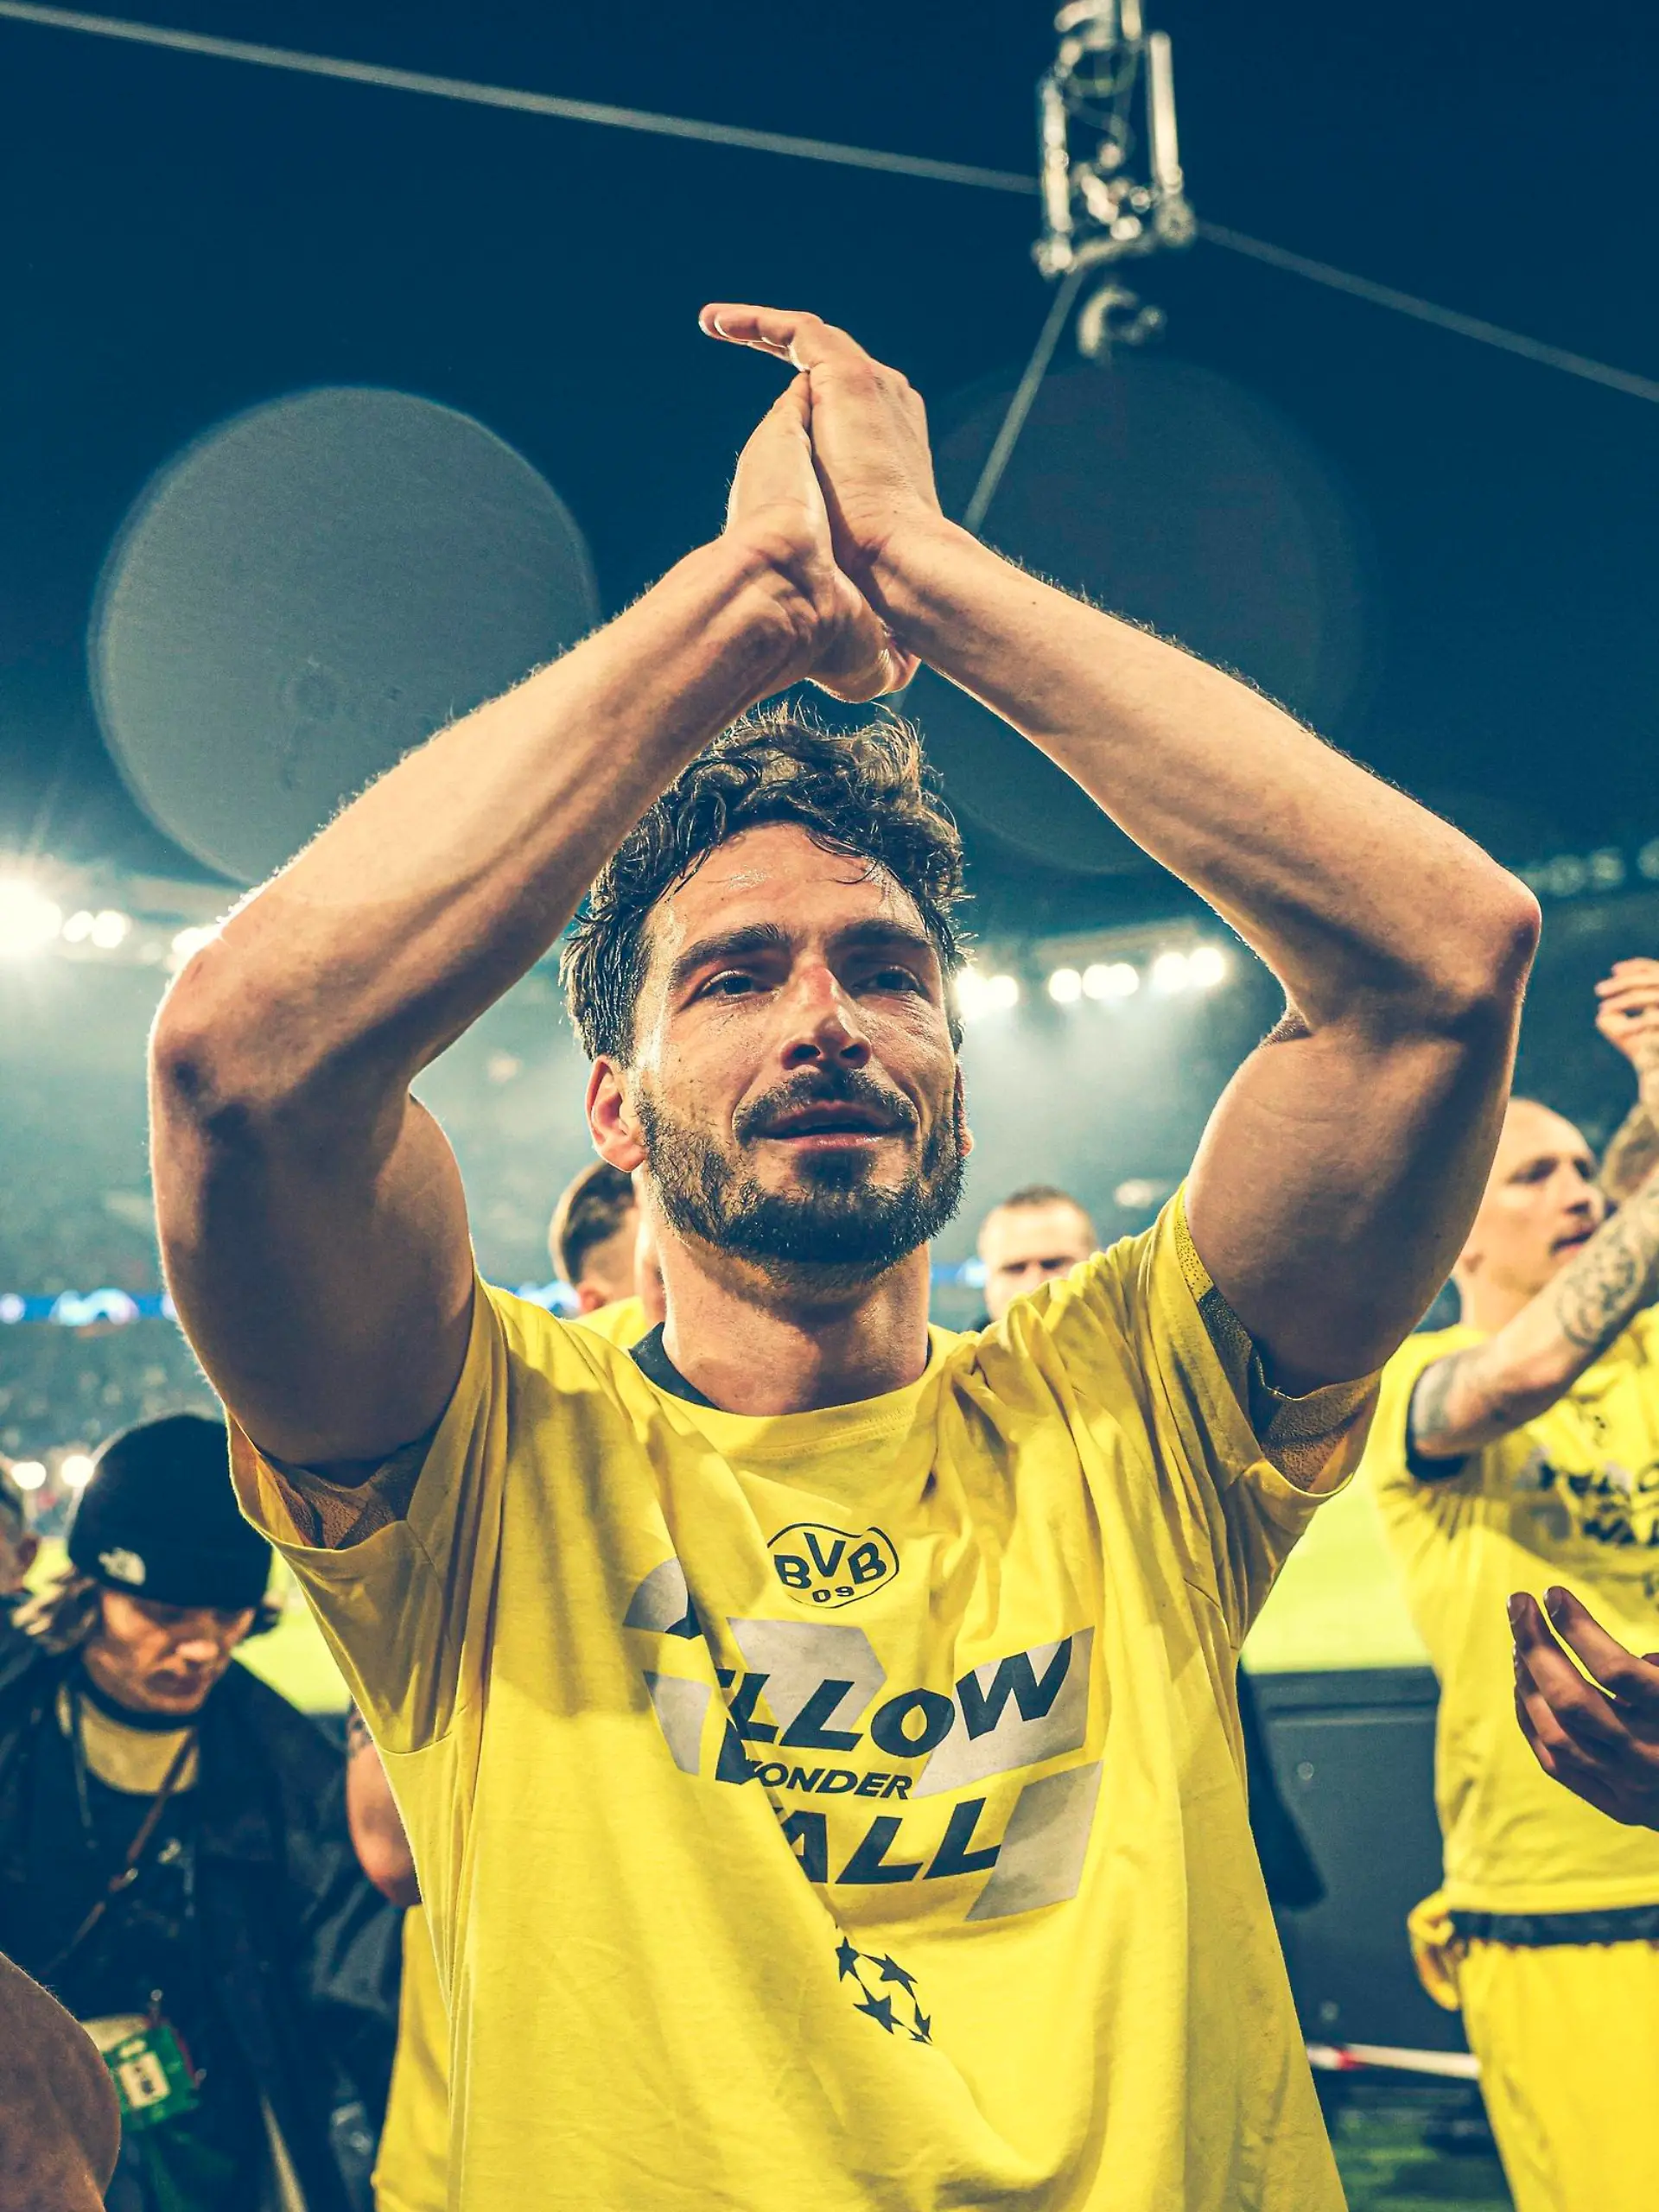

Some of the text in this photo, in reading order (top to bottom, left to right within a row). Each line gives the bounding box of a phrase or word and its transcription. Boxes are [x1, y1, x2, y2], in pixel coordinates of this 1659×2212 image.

[773, 1532, 887, 1589] BVB
[812, 1586, 855, 1603] 09
[747, 1758, 912, 1800] ONDER
[772, 1796, 1002, 1885] ALL
